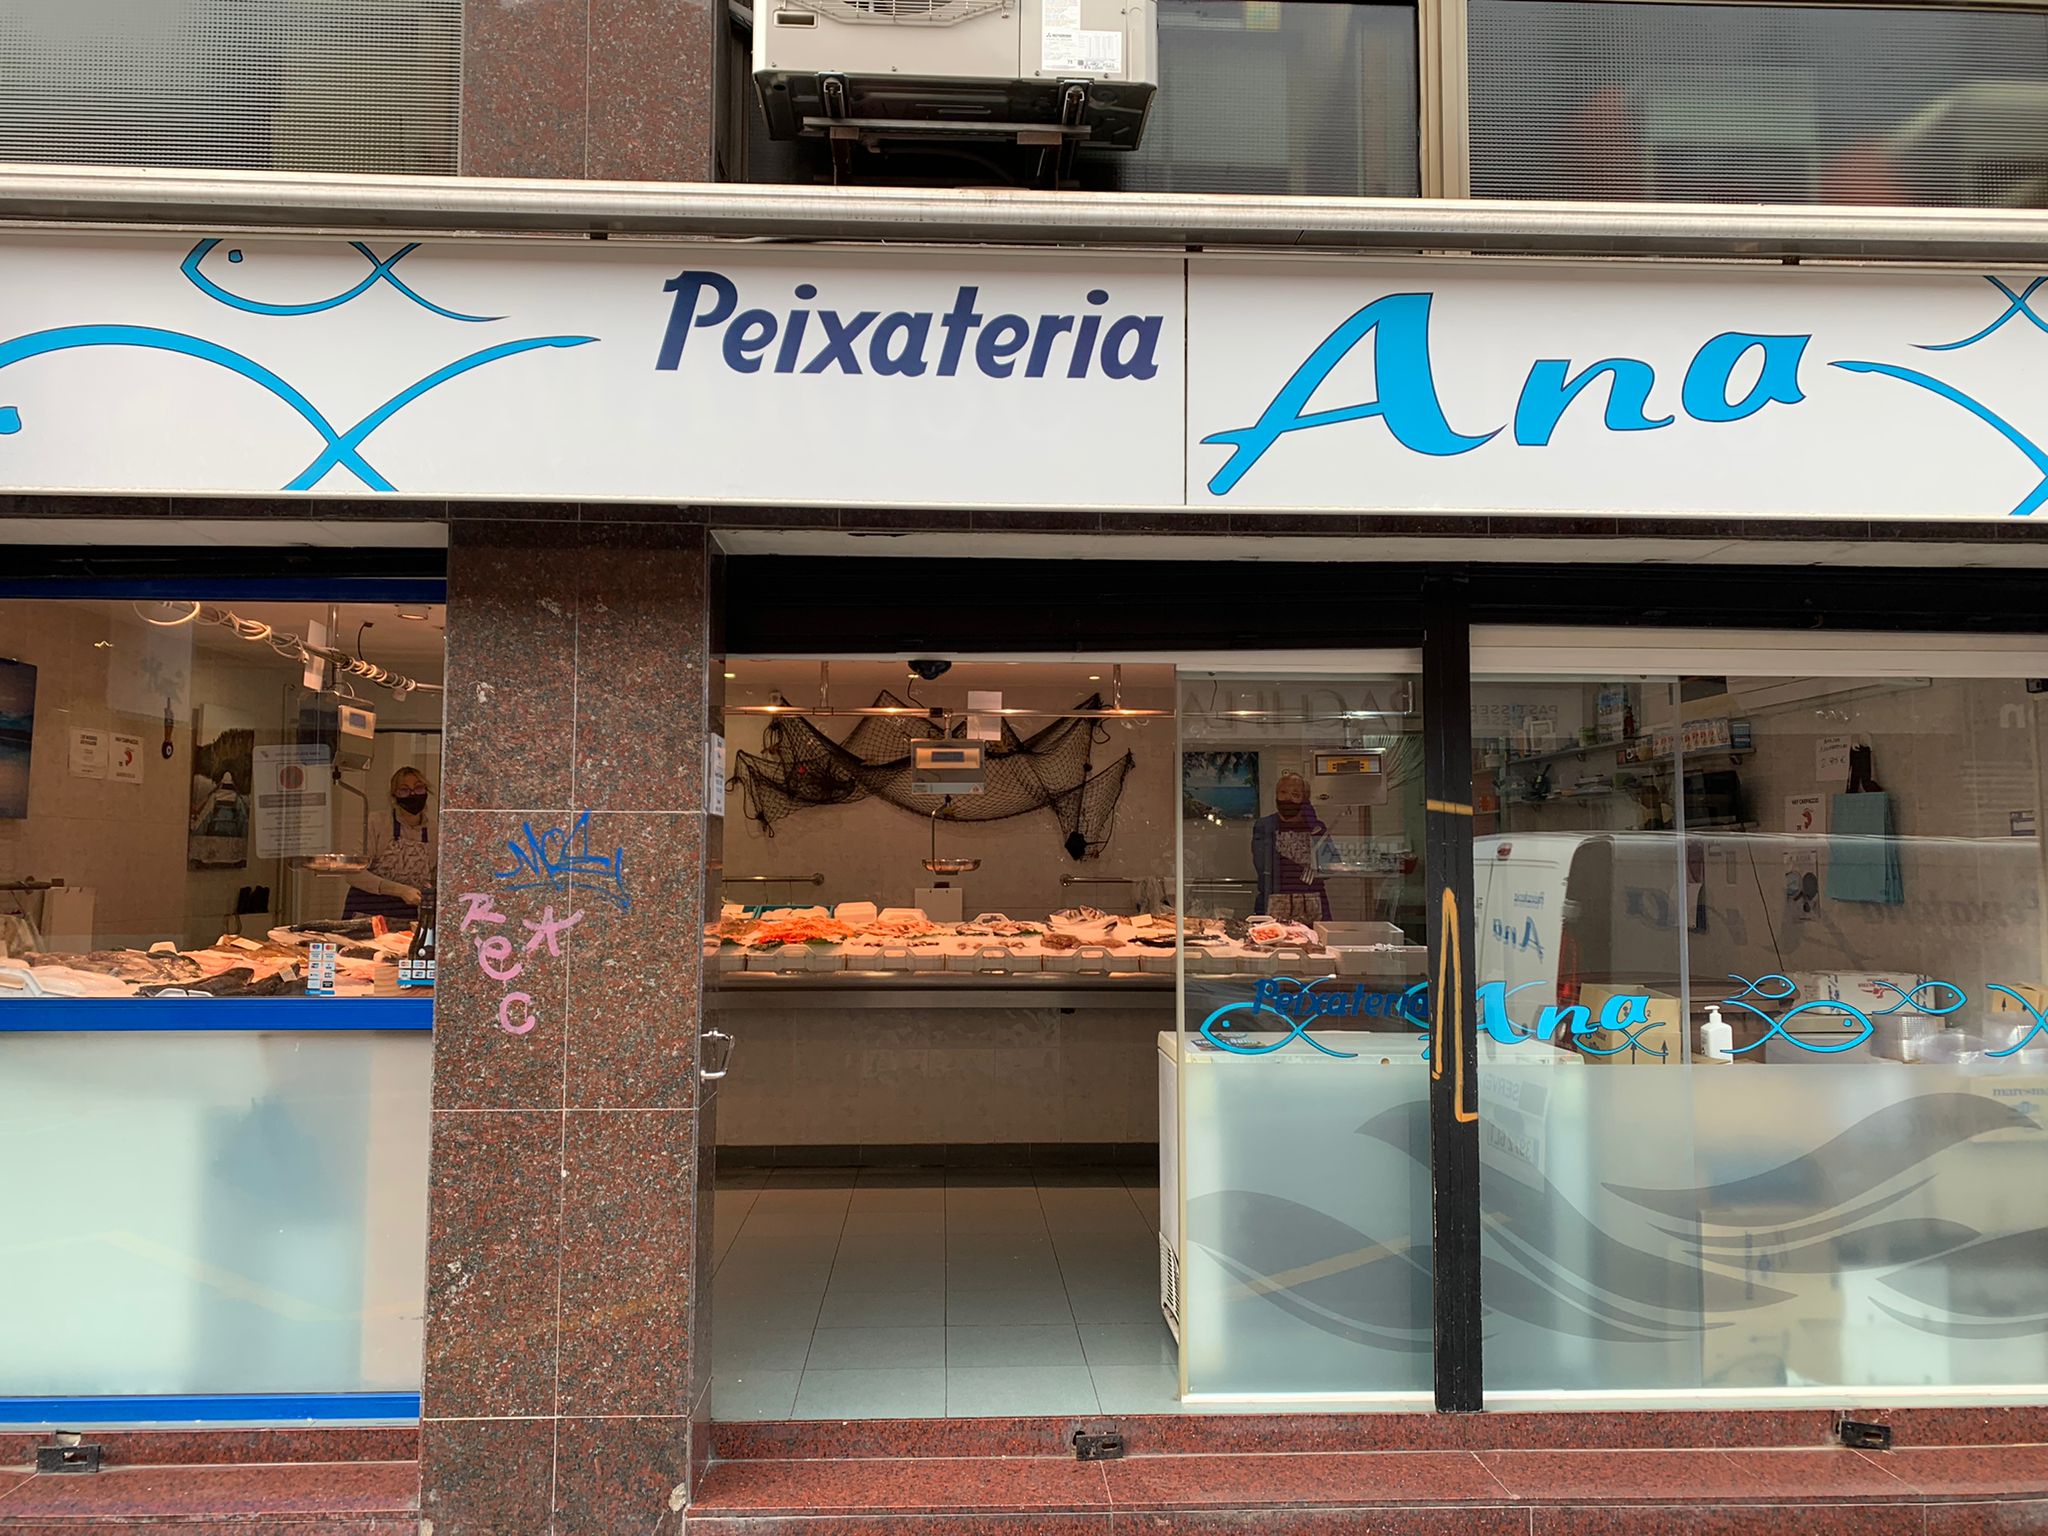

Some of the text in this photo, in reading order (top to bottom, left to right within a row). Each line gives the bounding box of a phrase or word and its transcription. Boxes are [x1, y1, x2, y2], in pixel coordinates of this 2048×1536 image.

[654, 270, 1812, 496] Peixateria Ana
[1252, 977, 1430, 1018] Peixateria
